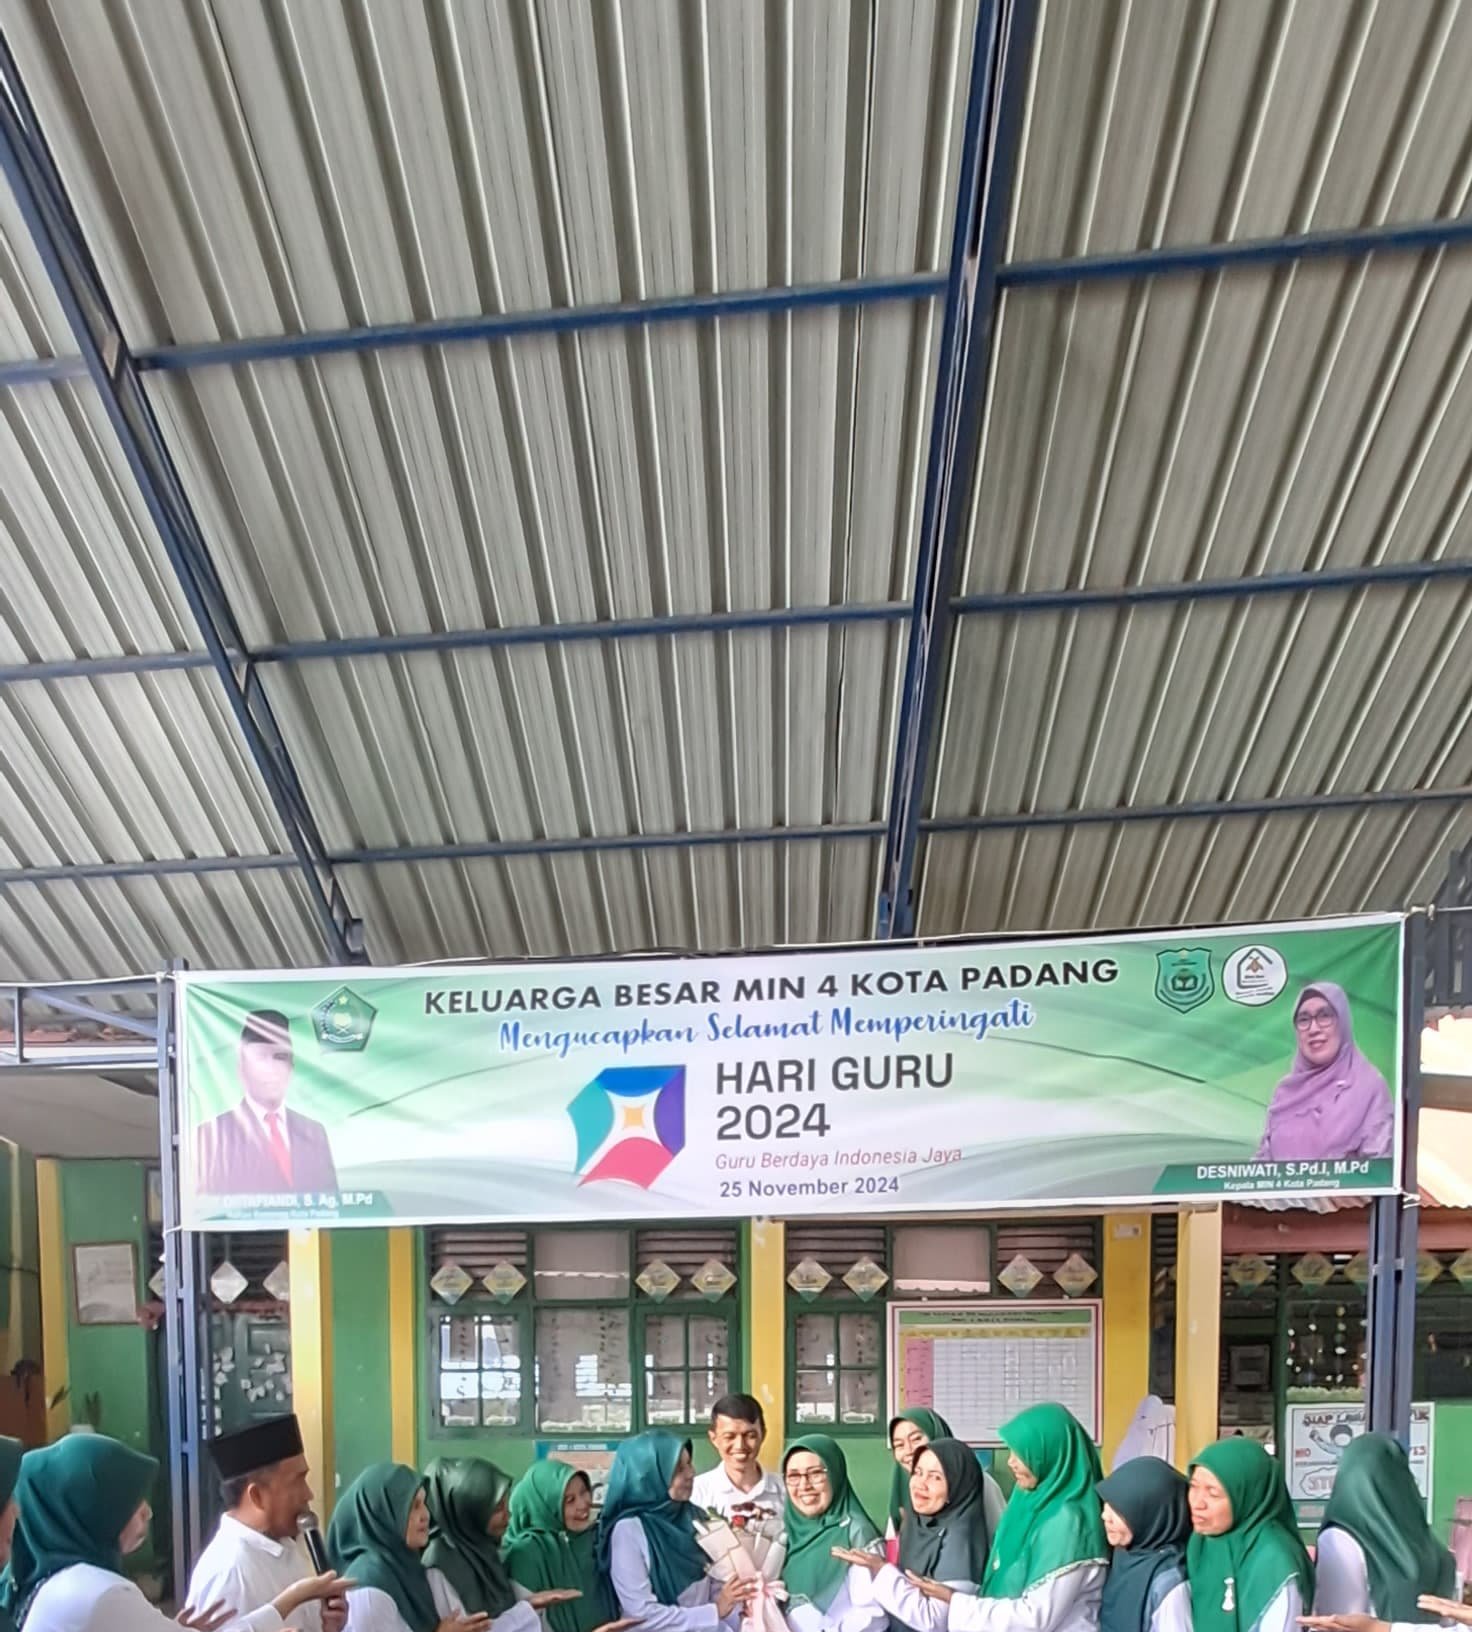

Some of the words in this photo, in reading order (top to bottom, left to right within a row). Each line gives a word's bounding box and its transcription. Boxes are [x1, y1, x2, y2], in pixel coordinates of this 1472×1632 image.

[424, 985, 602, 1015] KELUARGA
[614, 980, 721, 1007] BESAR
[733, 975, 806, 1002] MIN
[817, 976, 839, 998] 4
[850, 969, 949, 997] KOTA
[960, 958, 1119, 991] PADANG
[499, 1018, 699, 1059] Mengucapkan
[707, 1006, 823, 1041] Selamat
[830, 998, 1034, 1043] Memperingati
[716, 1058, 816, 1095] HARI
[831, 1052, 953, 1091] GURU
[716, 1102, 832, 1141] 2024
[715, 1153, 756, 1170] Guru
[760, 1150, 829, 1171] Berdaya
[834, 1148, 917, 1166] Indonesia
[921, 1147, 963, 1168] Jaya
[1196, 1162, 1282, 1180] DESNIWATI,
[1334, 1160, 1370, 1174] M.Pd
[720, 1181, 742, 1198] 25
[749, 1178, 849, 1198] November
[854, 1176, 900, 1194] 2024
[1256, 1179, 1275, 1190] MIN
[1284, 1178, 1305, 1189] Kota
[1306, 1177, 1341, 1190] Padang
